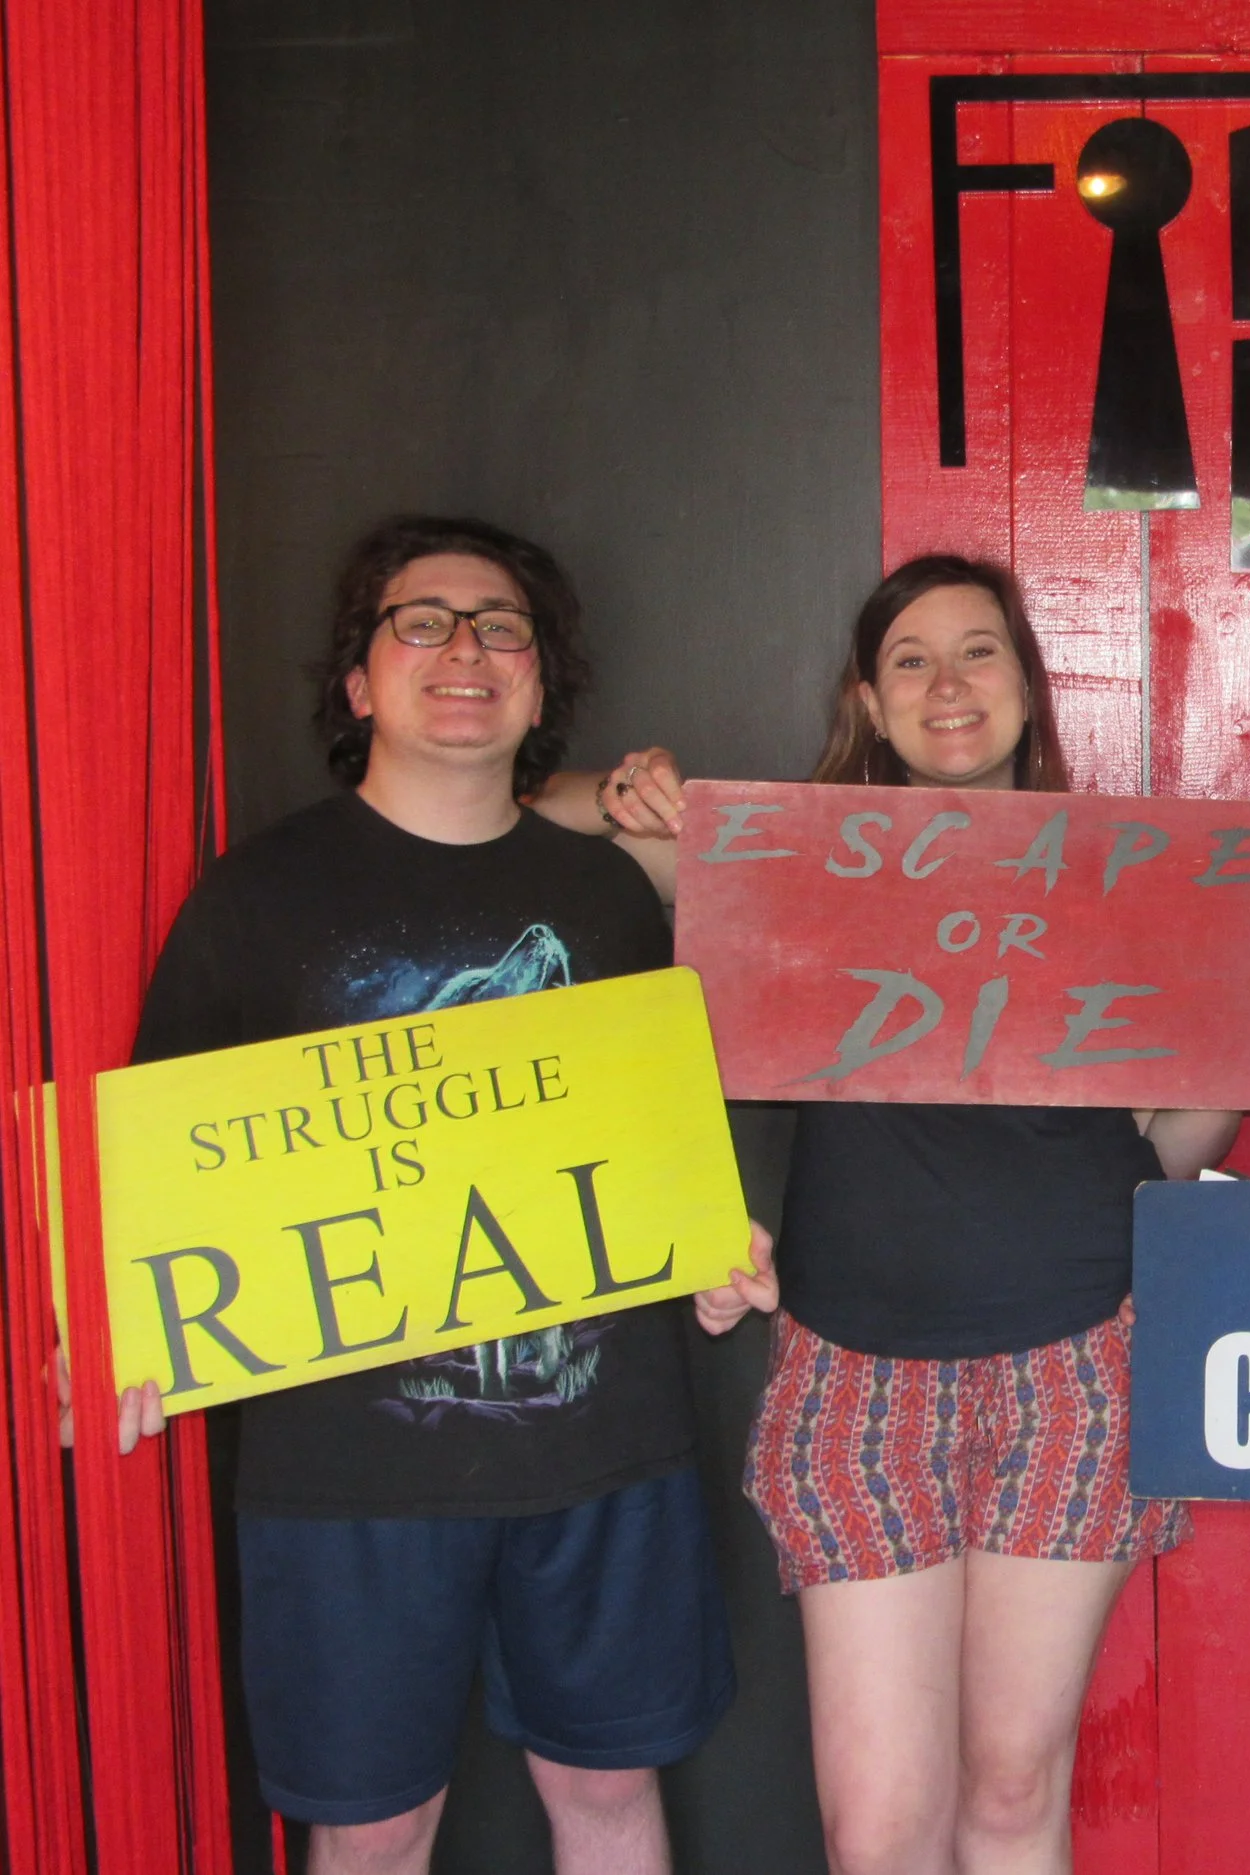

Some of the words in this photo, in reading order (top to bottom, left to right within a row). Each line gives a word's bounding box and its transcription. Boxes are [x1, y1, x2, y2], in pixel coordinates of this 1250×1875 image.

[936, 910, 1048, 960] OR
[302, 1023, 444, 1090] THE
[772, 967, 1181, 1084] DIE
[189, 1055, 570, 1173] STRUGGLE
[367, 1139, 426, 1193] IS
[130, 1159, 676, 1398] REAL
